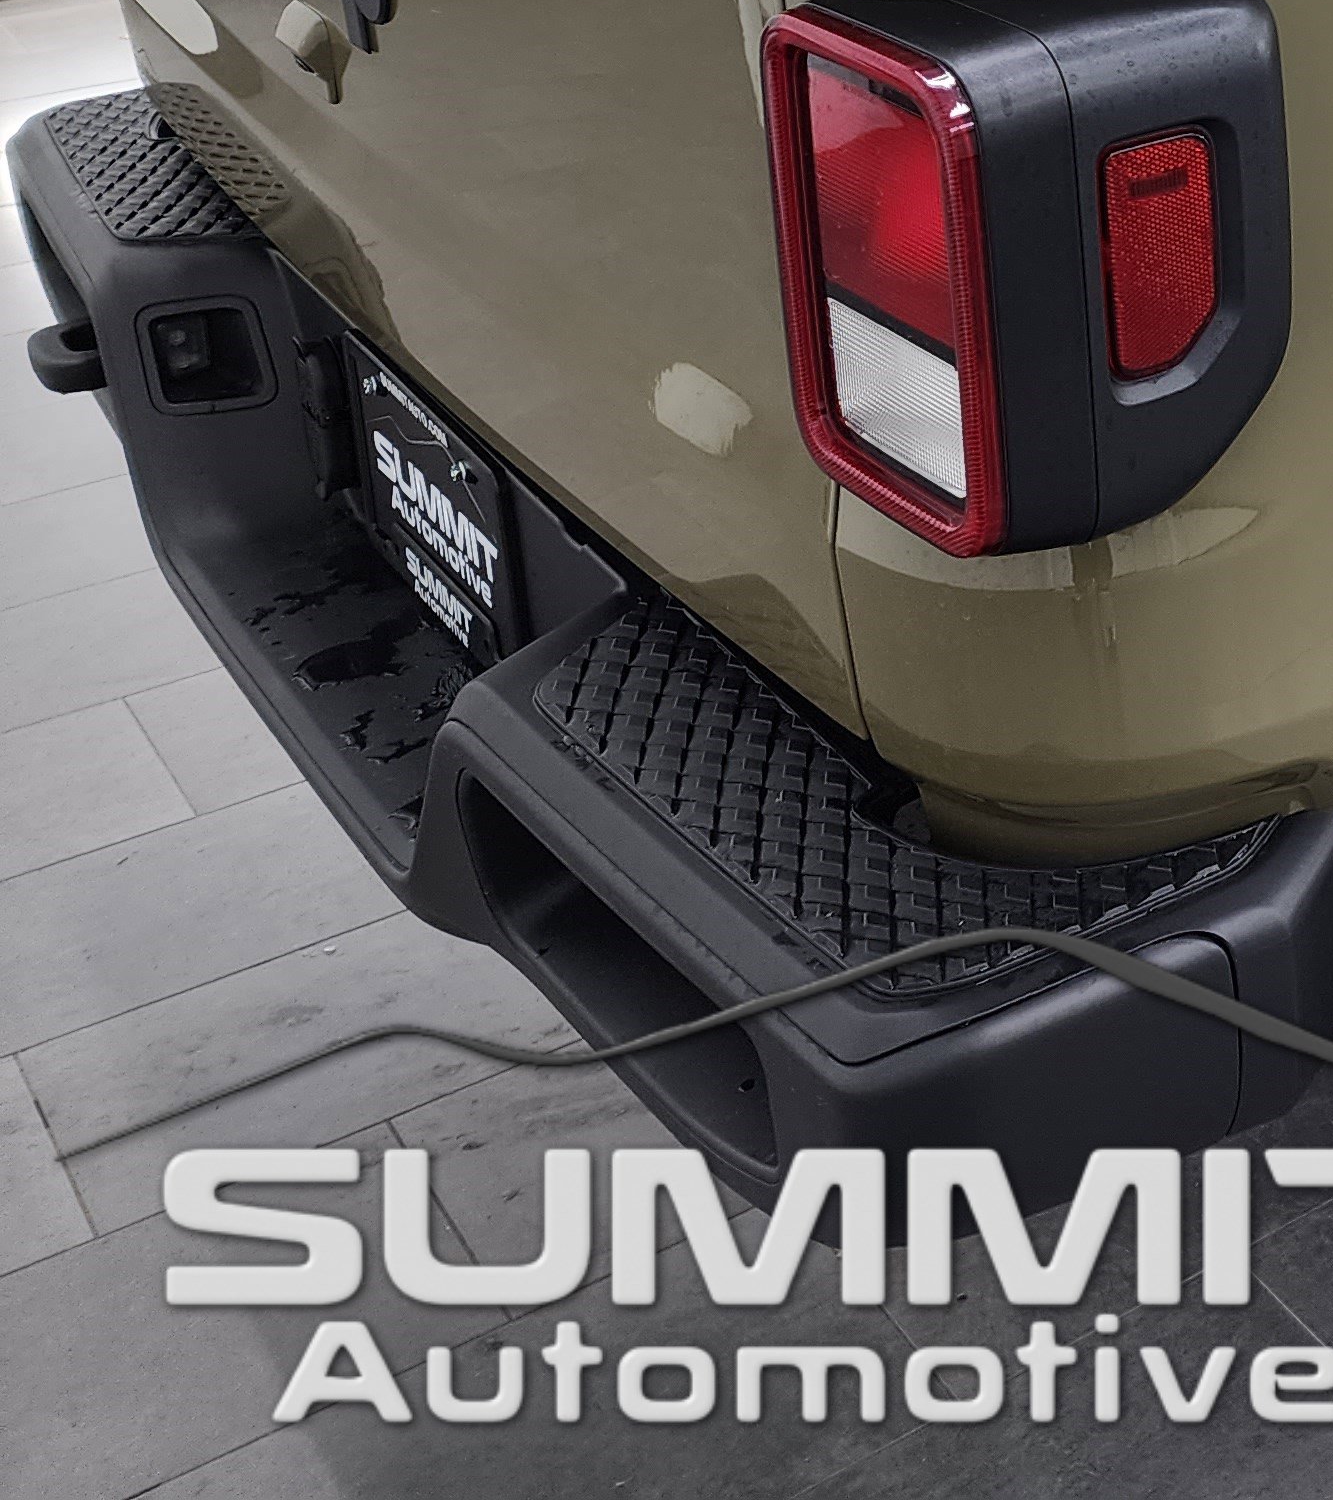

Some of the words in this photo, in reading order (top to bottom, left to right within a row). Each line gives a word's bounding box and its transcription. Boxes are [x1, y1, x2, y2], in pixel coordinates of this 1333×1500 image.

[373, 430, 498, 583] SUMMIT
[391, 485, 493, 609] Automotive
[405, 547, 473, 633] SUMMIT
[414, 581, 469, 649] Automotive
